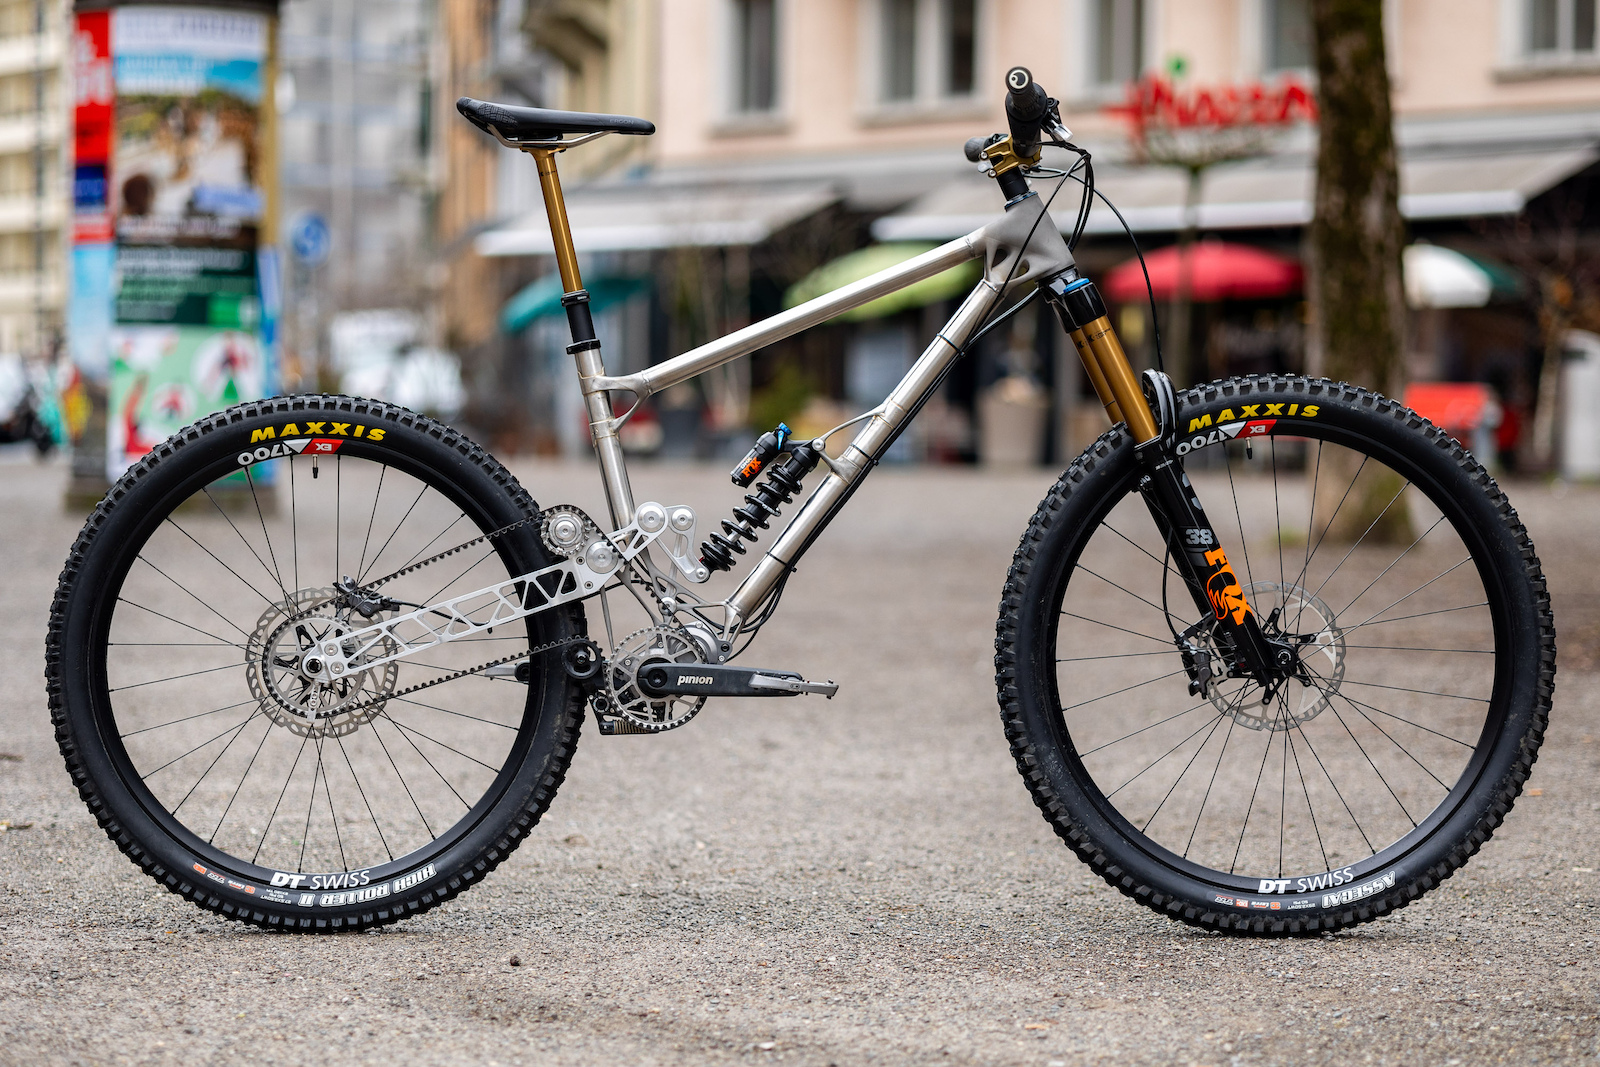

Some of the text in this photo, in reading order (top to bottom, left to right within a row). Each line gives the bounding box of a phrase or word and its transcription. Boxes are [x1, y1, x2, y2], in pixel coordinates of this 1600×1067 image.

[1188, 403, 1320, 433] MAXXIS
[250, 422, 386, 443] MAXXIS
[1176, 425, 1266, 456] EX 1700
[237, 443, 332, 466] EX 1700
[741, 457, 762, 478] FOX
[1185, 529, 1213, 544] 38
[1204, 545, 1254, 626] FOX
[677, 675, 714, 686] pinion
[270, 870, 370, 890] DT SWISS
[392, 863, 437, 894] HIGH
[1257, 867, 1354, 894] DT SWISS
[1321, 870, 1396, 909] ASSEGAI
[319, 882, 391, 907] ROLLER
